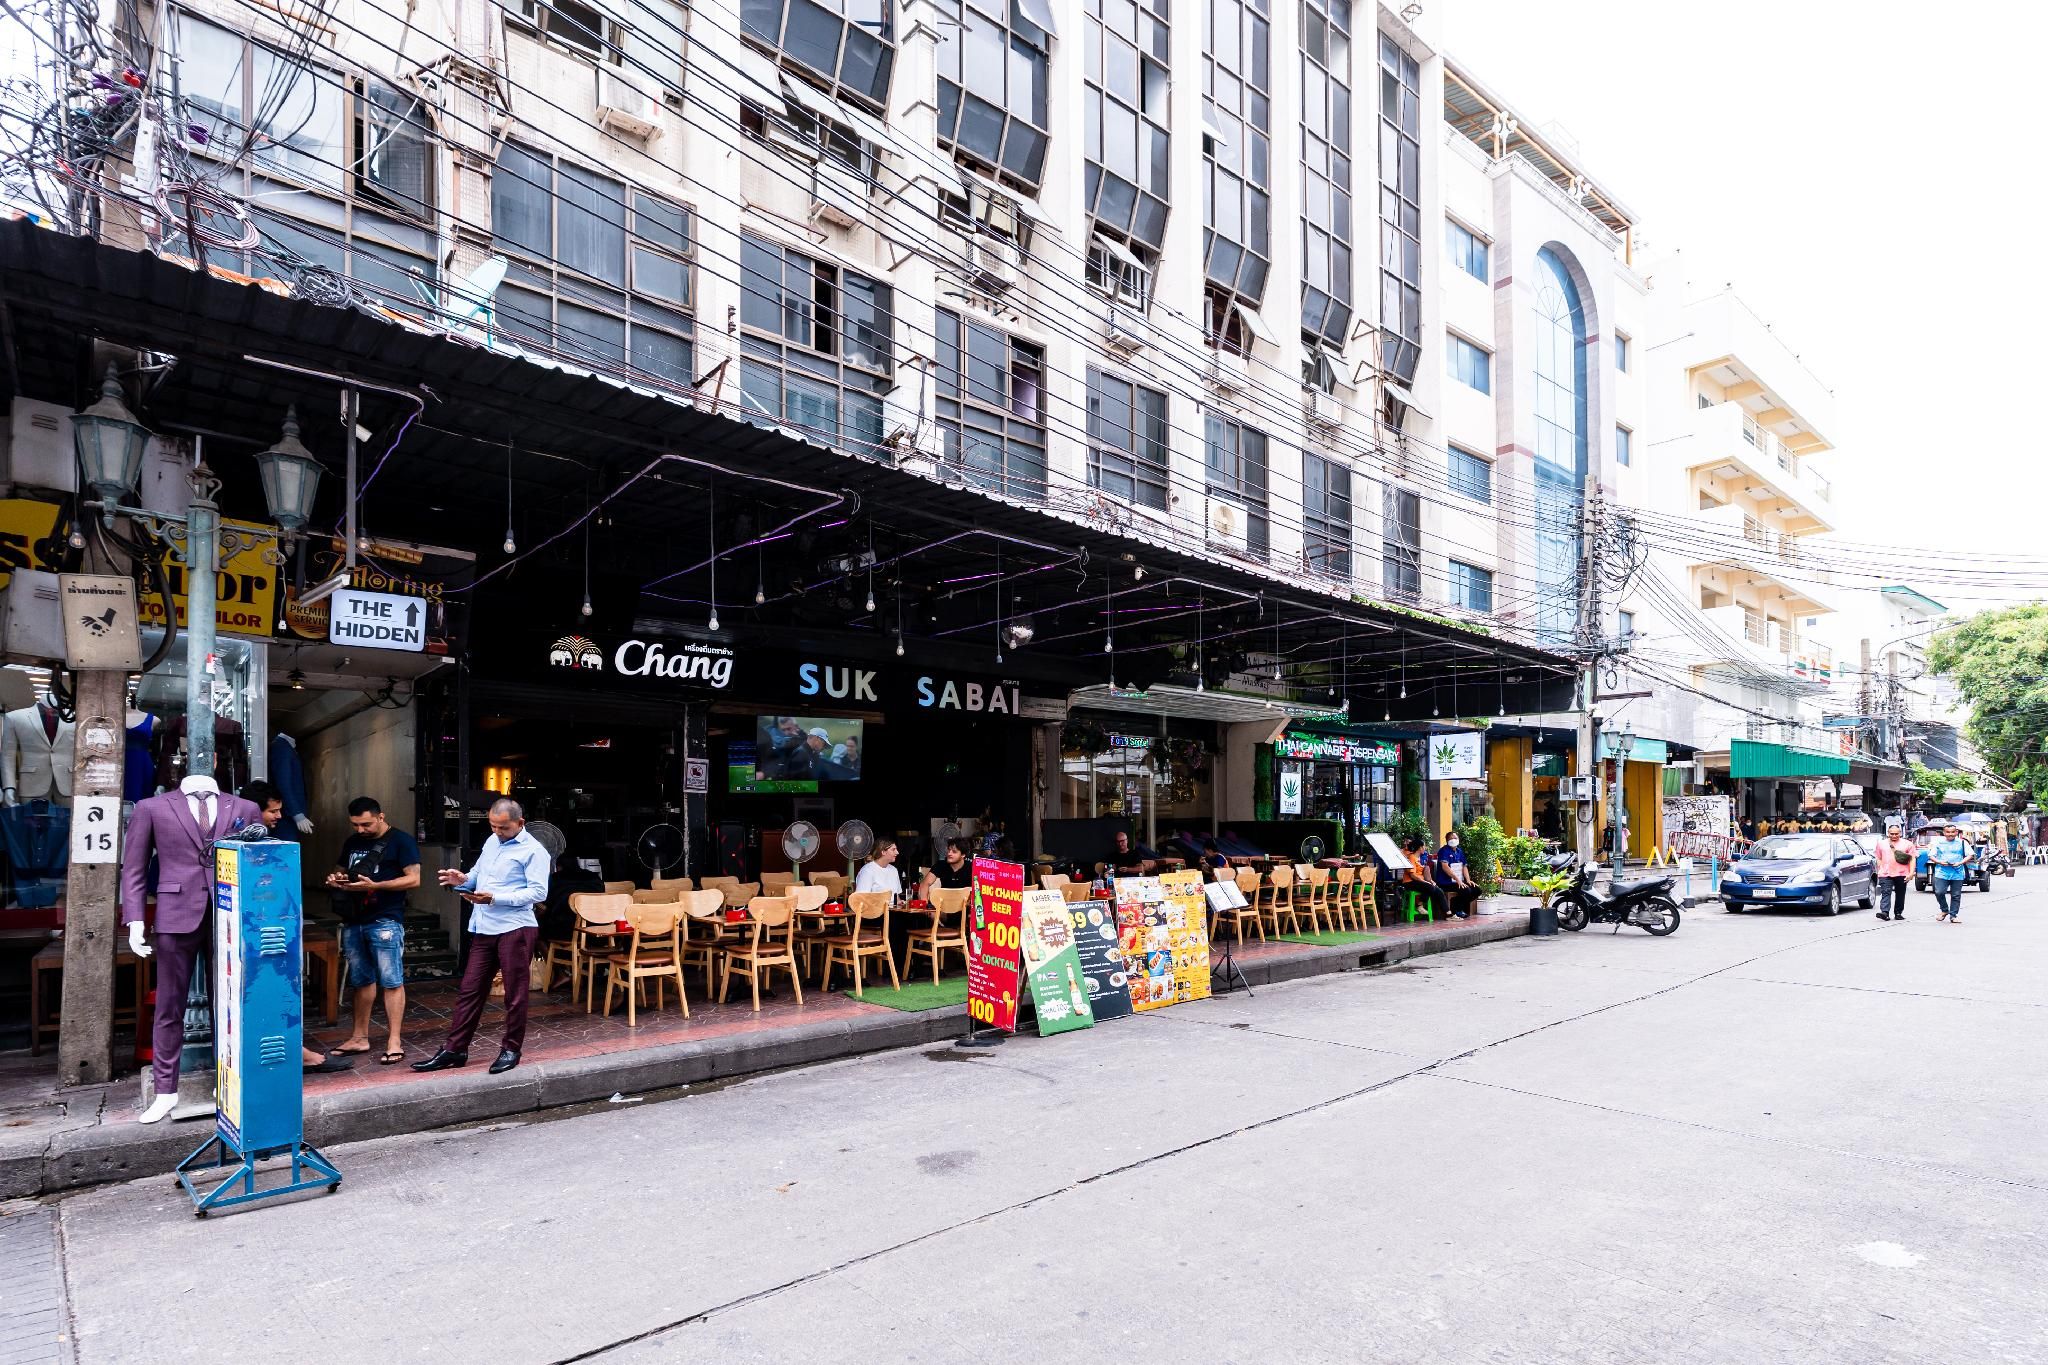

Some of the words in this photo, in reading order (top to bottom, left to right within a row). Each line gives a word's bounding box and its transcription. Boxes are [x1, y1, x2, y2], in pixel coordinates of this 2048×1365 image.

[349, 599, 392, 618] THE
[335, 621, 420, 644] HIDDEN
[615, 640, 734, 688] Chang
[799, 663, 878, 701] SUK
[917, 676, 1020, 715] SABAI
[1349, 746, 1399, 763] DISPENSARY
[84, 833, 112, 851] 15
[975, 860, 999, 870] SPECIAL
[980, 871, 996, 881] PRICE
[981, 885, 994, 897] BIG
[995, 887, 1023, 903] CHANG
[992, 901, 1012, 916] BEER
[988, 921, 1020, 950] 100
[969, 997, 995, 1024] 100
